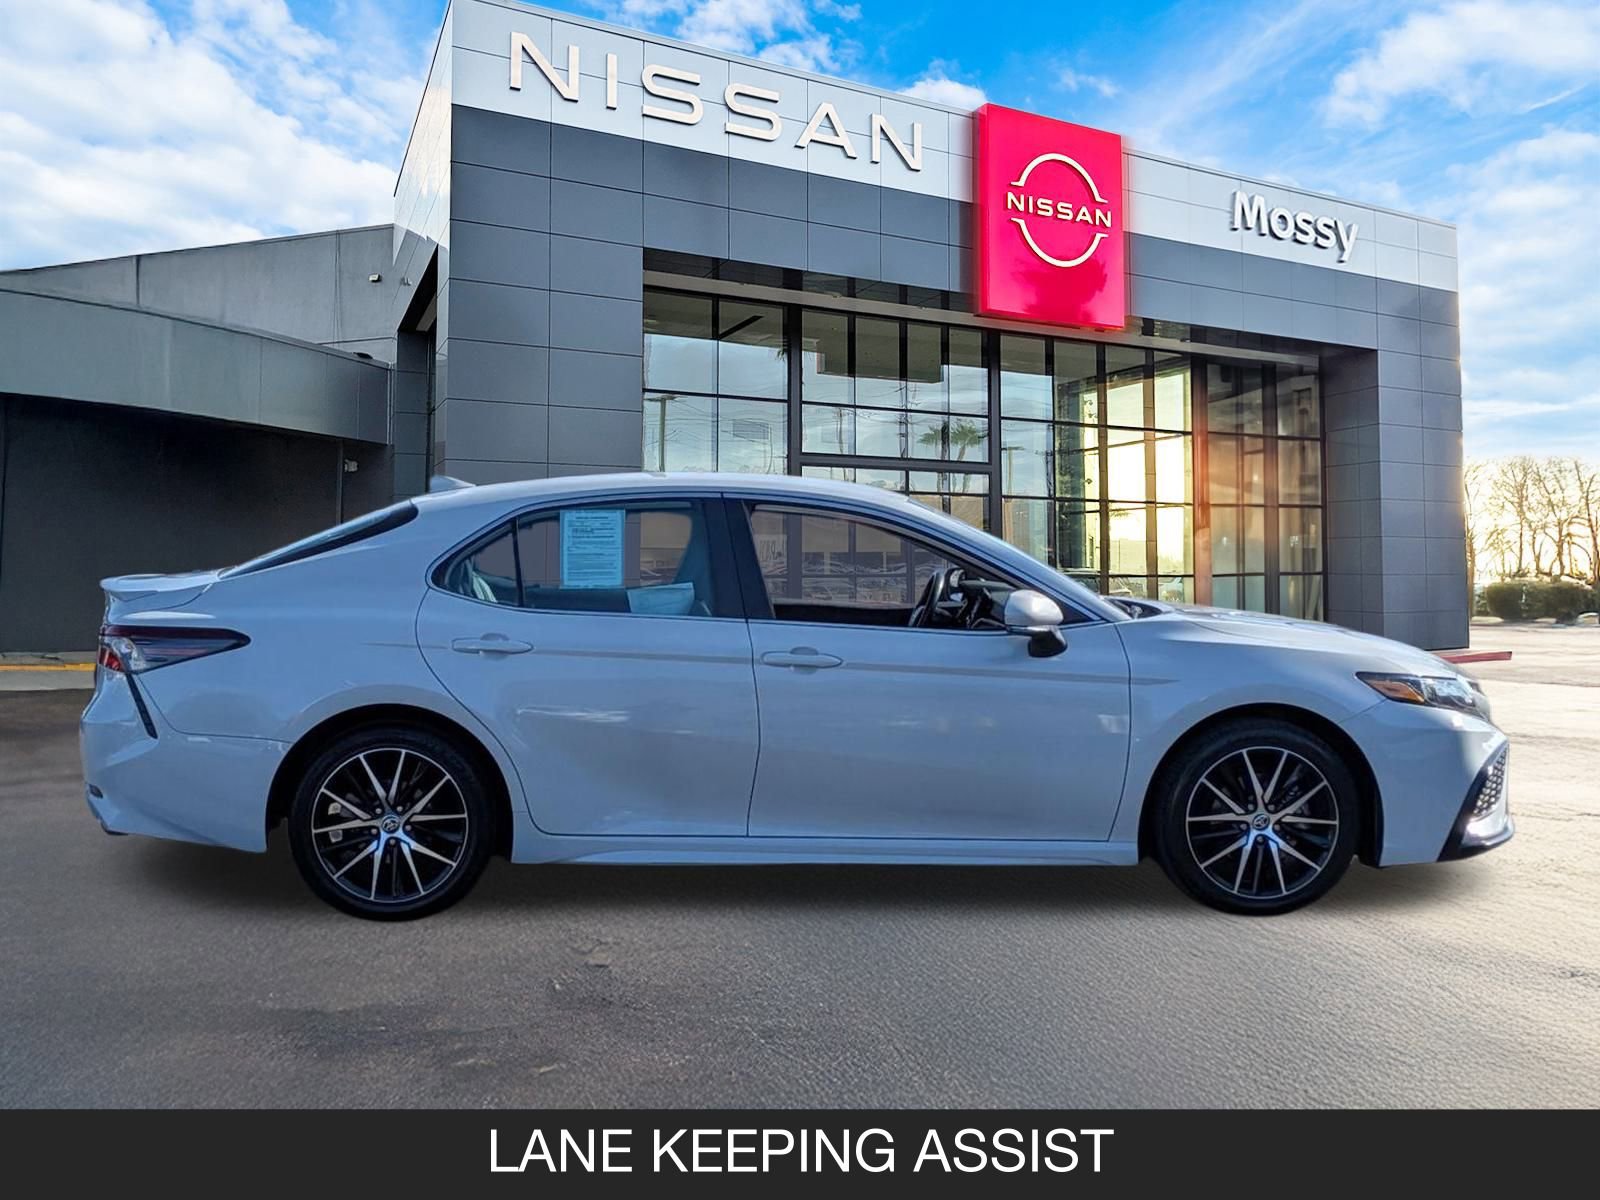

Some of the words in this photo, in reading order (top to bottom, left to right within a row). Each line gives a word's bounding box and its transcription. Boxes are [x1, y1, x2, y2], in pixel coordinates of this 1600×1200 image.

[509, 32, 923, 171] NISSAN
[1007, 191, 1112, 228] NISSAN
[1231, 191, 1360, 263] Mossy
